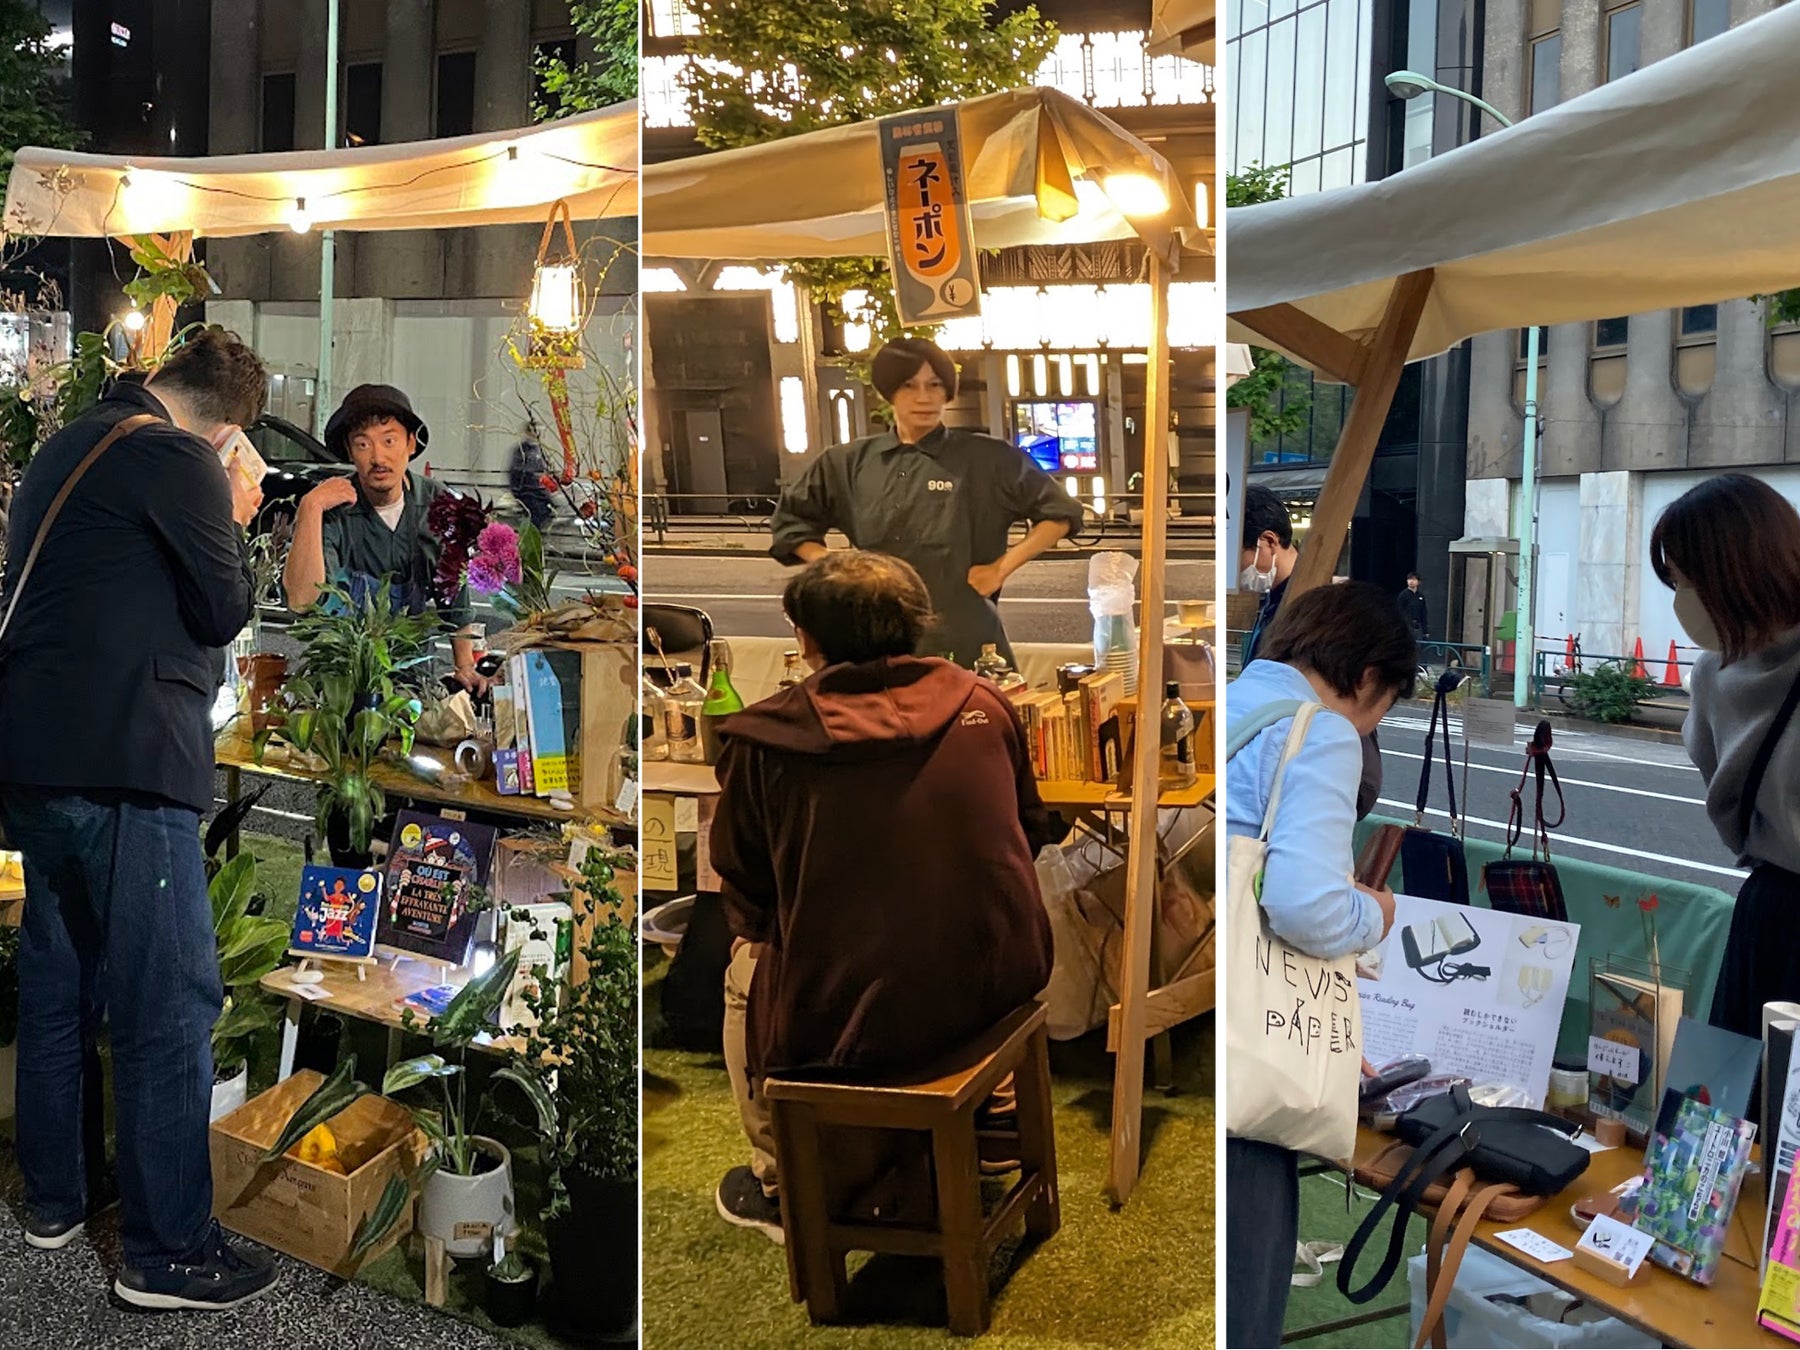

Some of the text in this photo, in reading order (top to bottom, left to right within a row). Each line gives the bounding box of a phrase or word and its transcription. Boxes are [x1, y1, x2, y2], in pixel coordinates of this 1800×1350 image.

[907, 159, 946, 270] ネーポン
[433, 868, 451, 880] EST
[411, 888, 423, 899] LA
[400, 895, 449, 915] EFFRAYANTE
[319, 907, 349, 922] Jazz
[401, 907, 444, 925] AVENTURE
[1373, 993, 1400, 1008] Reading
[1401, 997, 1416, 1011] Bag
[1265, 997, 1356, 1056] PAPER
